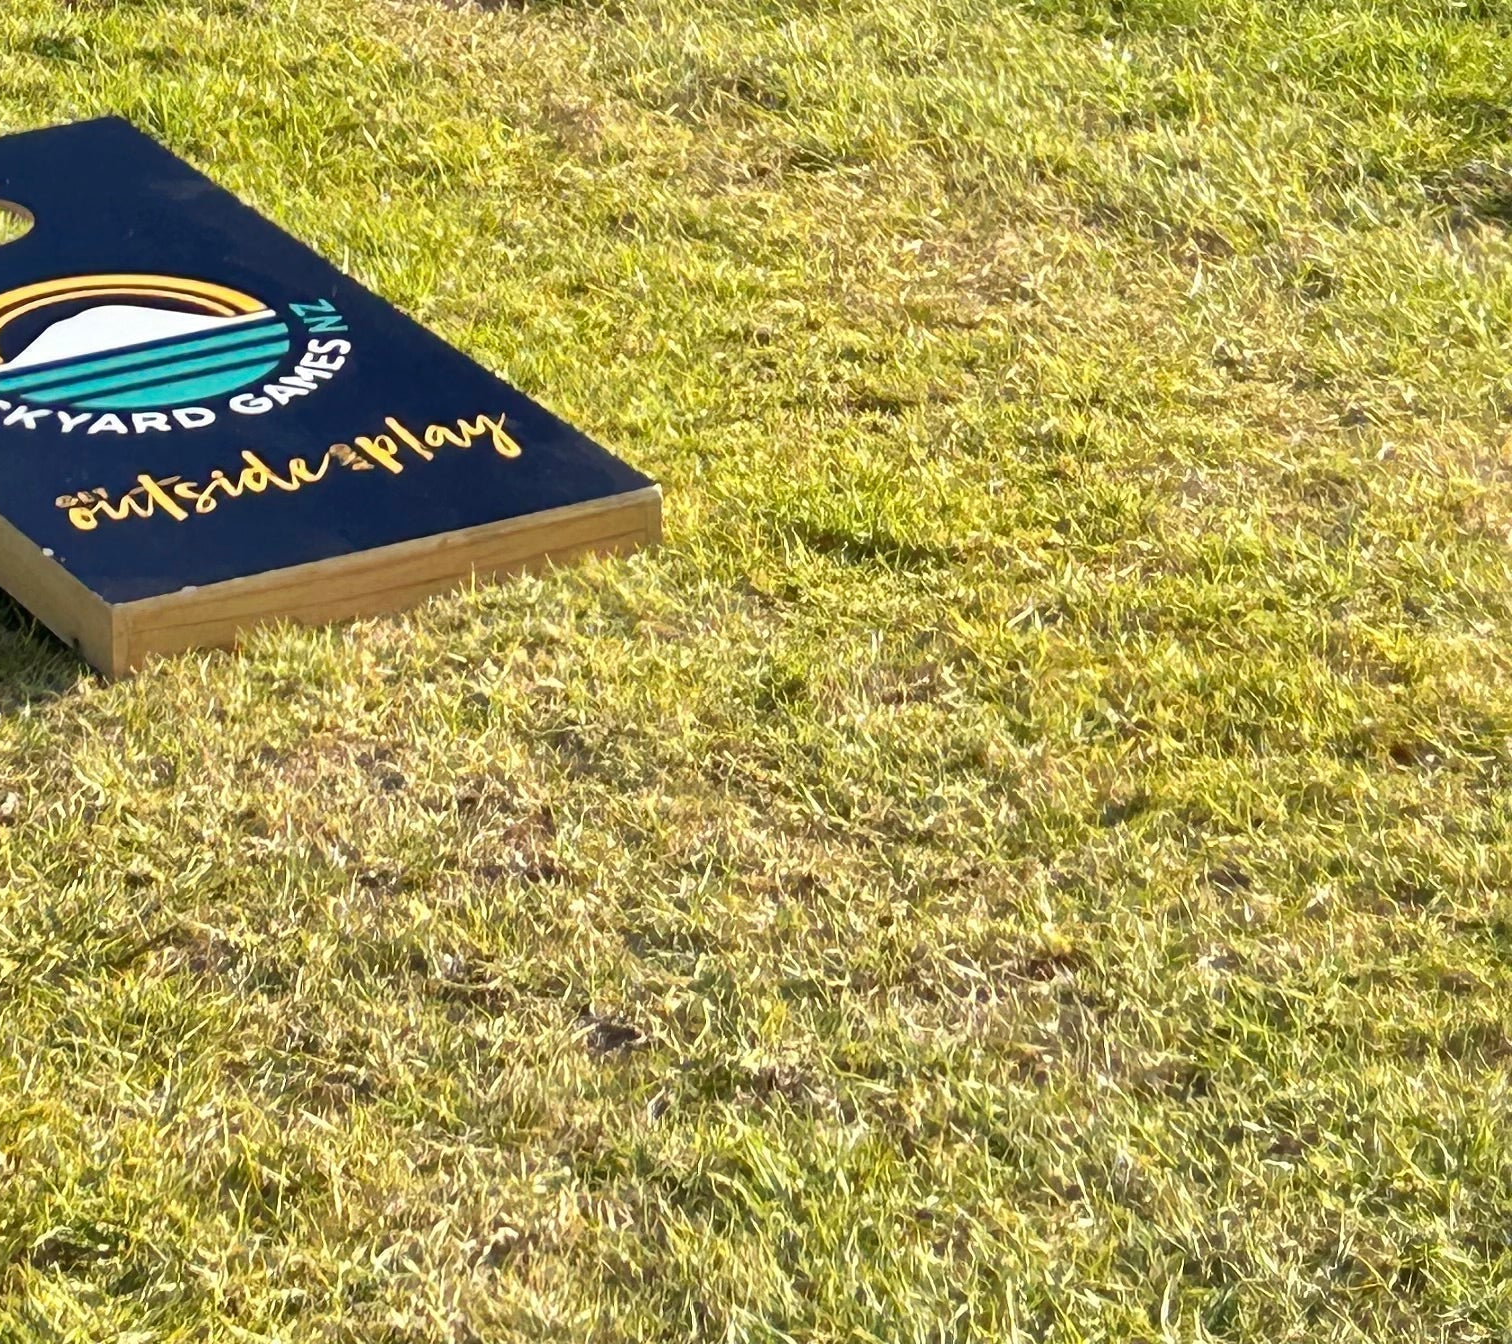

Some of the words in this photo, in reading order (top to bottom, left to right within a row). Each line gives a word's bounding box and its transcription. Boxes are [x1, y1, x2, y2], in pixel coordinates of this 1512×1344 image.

[288, 298, 348, 332] NZ
[229, 338, 351, 414] GAMES
[68, 449, 331, 531] outside
[353, 411, 522, 474] play
